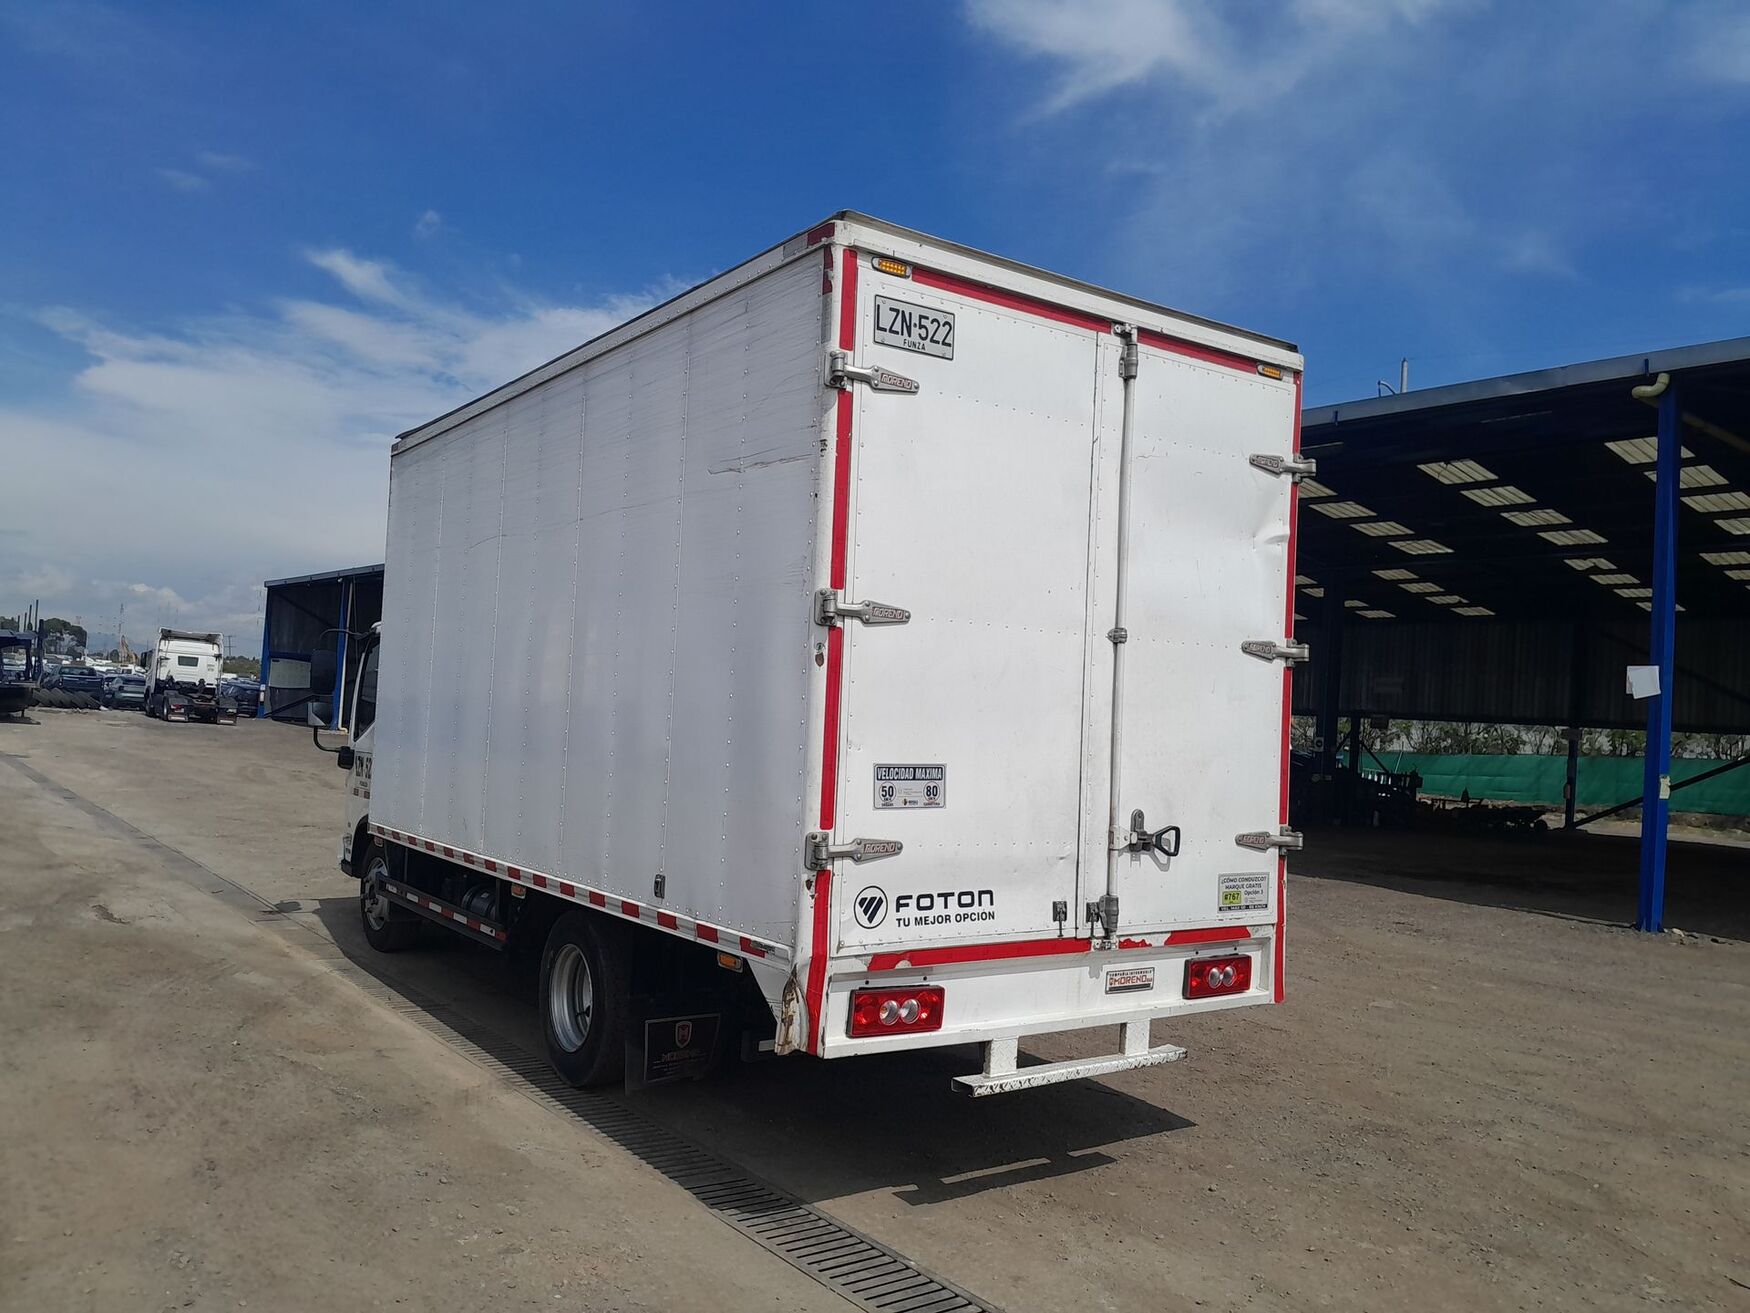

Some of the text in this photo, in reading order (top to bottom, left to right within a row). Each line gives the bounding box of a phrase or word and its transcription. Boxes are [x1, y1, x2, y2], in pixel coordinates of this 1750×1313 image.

[902, 338, 926, 351] FUNZA
[877, 767, 942, 780] VELOCIDAD MAXIMA
[881, 785, 894, 798] 50
[925, 785, 938, 797] 80
[895, 889, 994, 913] FOTON
[895, 917, 911, 928] TU
[914, 914, 952, 926] MEJOR
[1113, 975, 1147, 985] MORENO
